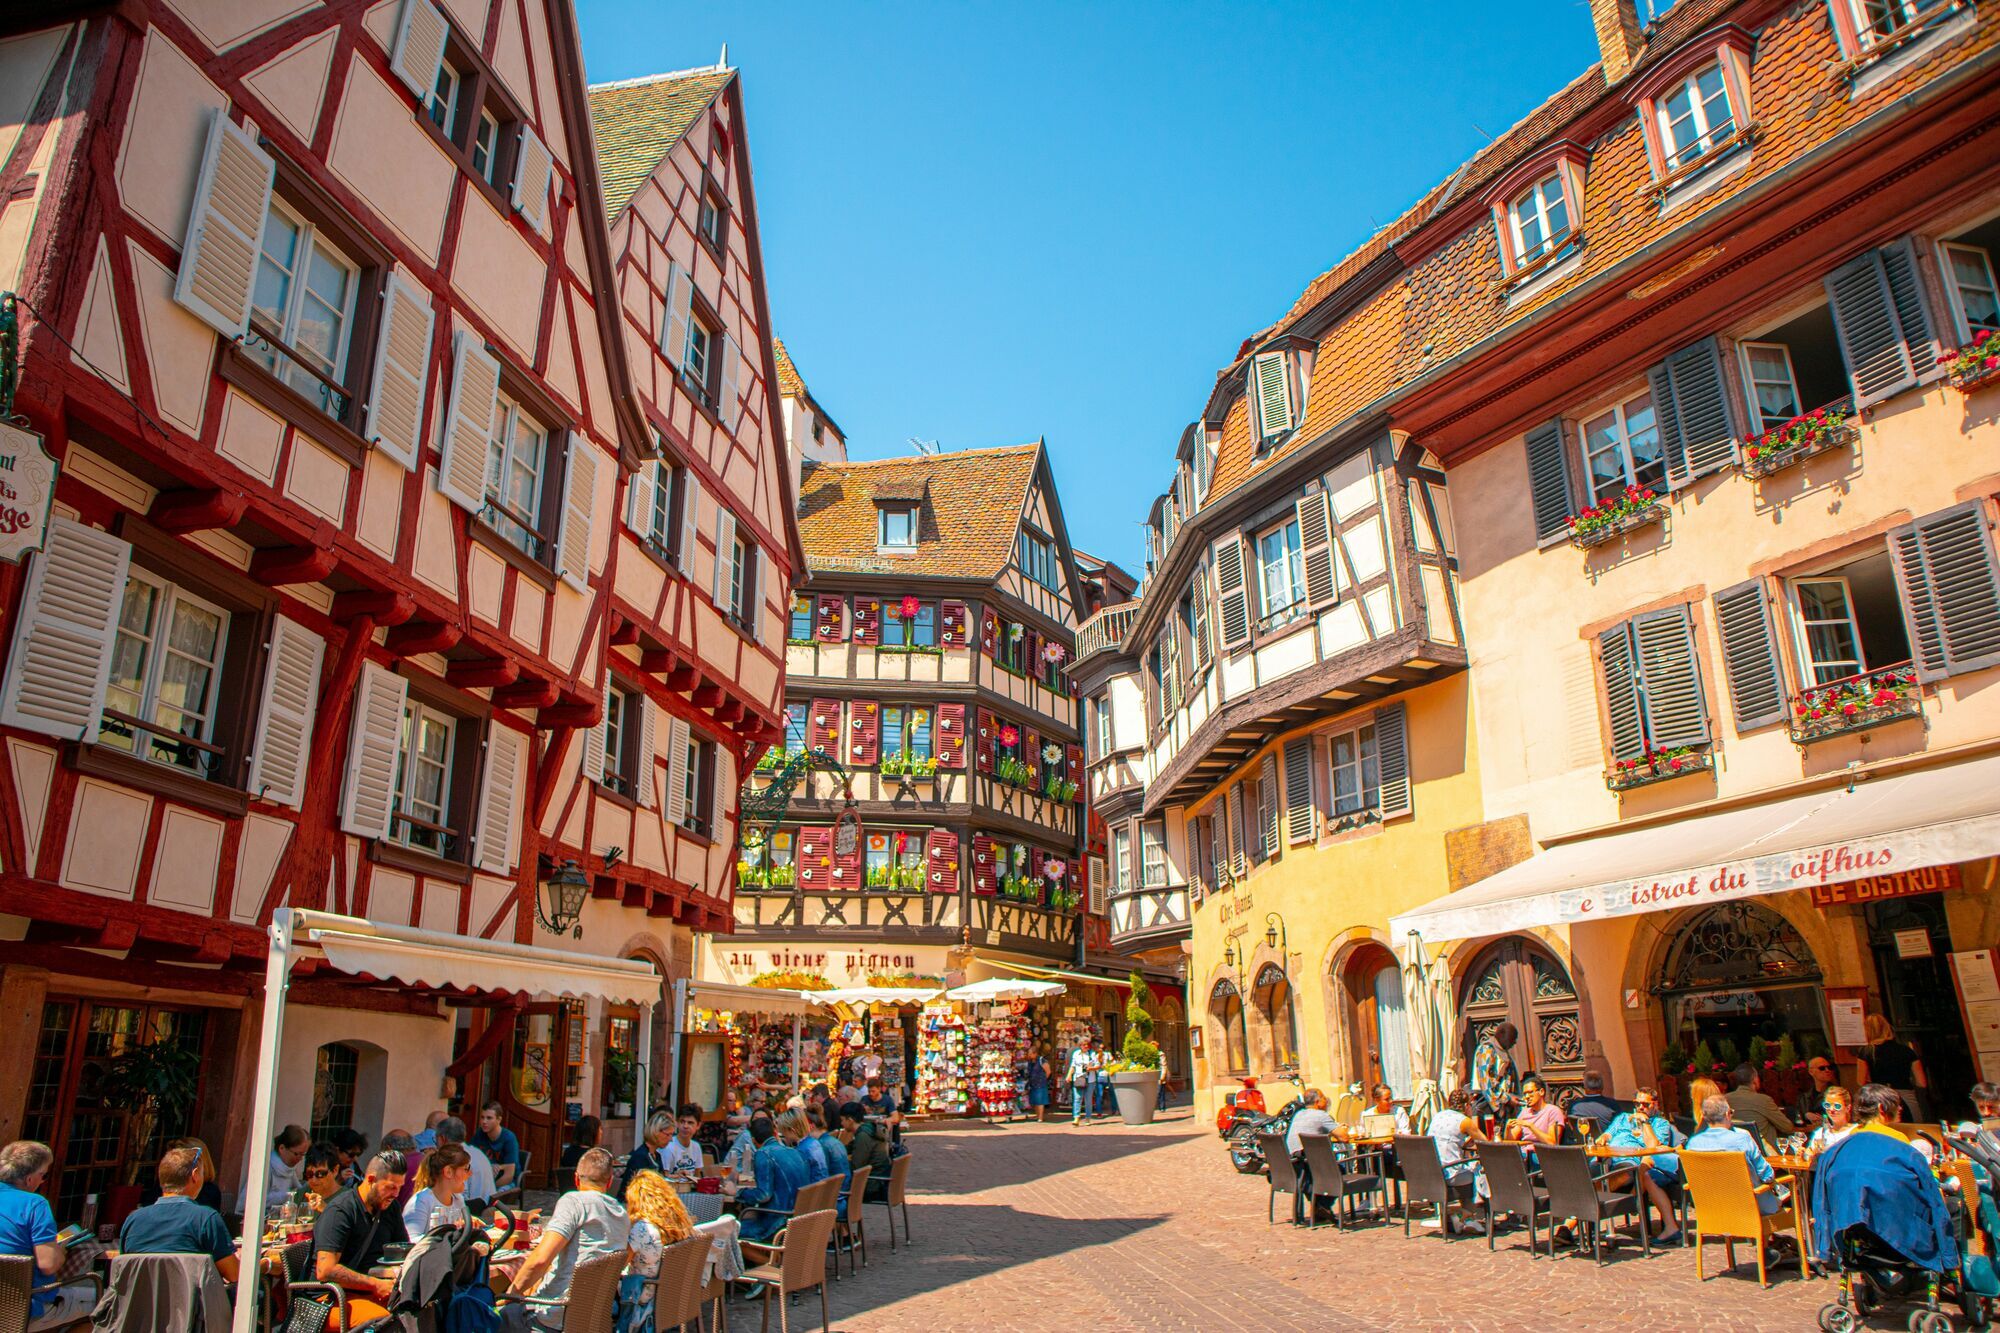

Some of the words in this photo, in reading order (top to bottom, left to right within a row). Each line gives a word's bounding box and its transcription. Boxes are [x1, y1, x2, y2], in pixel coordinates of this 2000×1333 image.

[1709, 867, 1750, 893] du
[1816, 884, 1847, 904] LE
[1856, 865, 1951, 899] BISTROT
[730, 953, 753, 966] au
[772, 947, 825, 967] vieux
[846, 948, 914, 973] pignon
